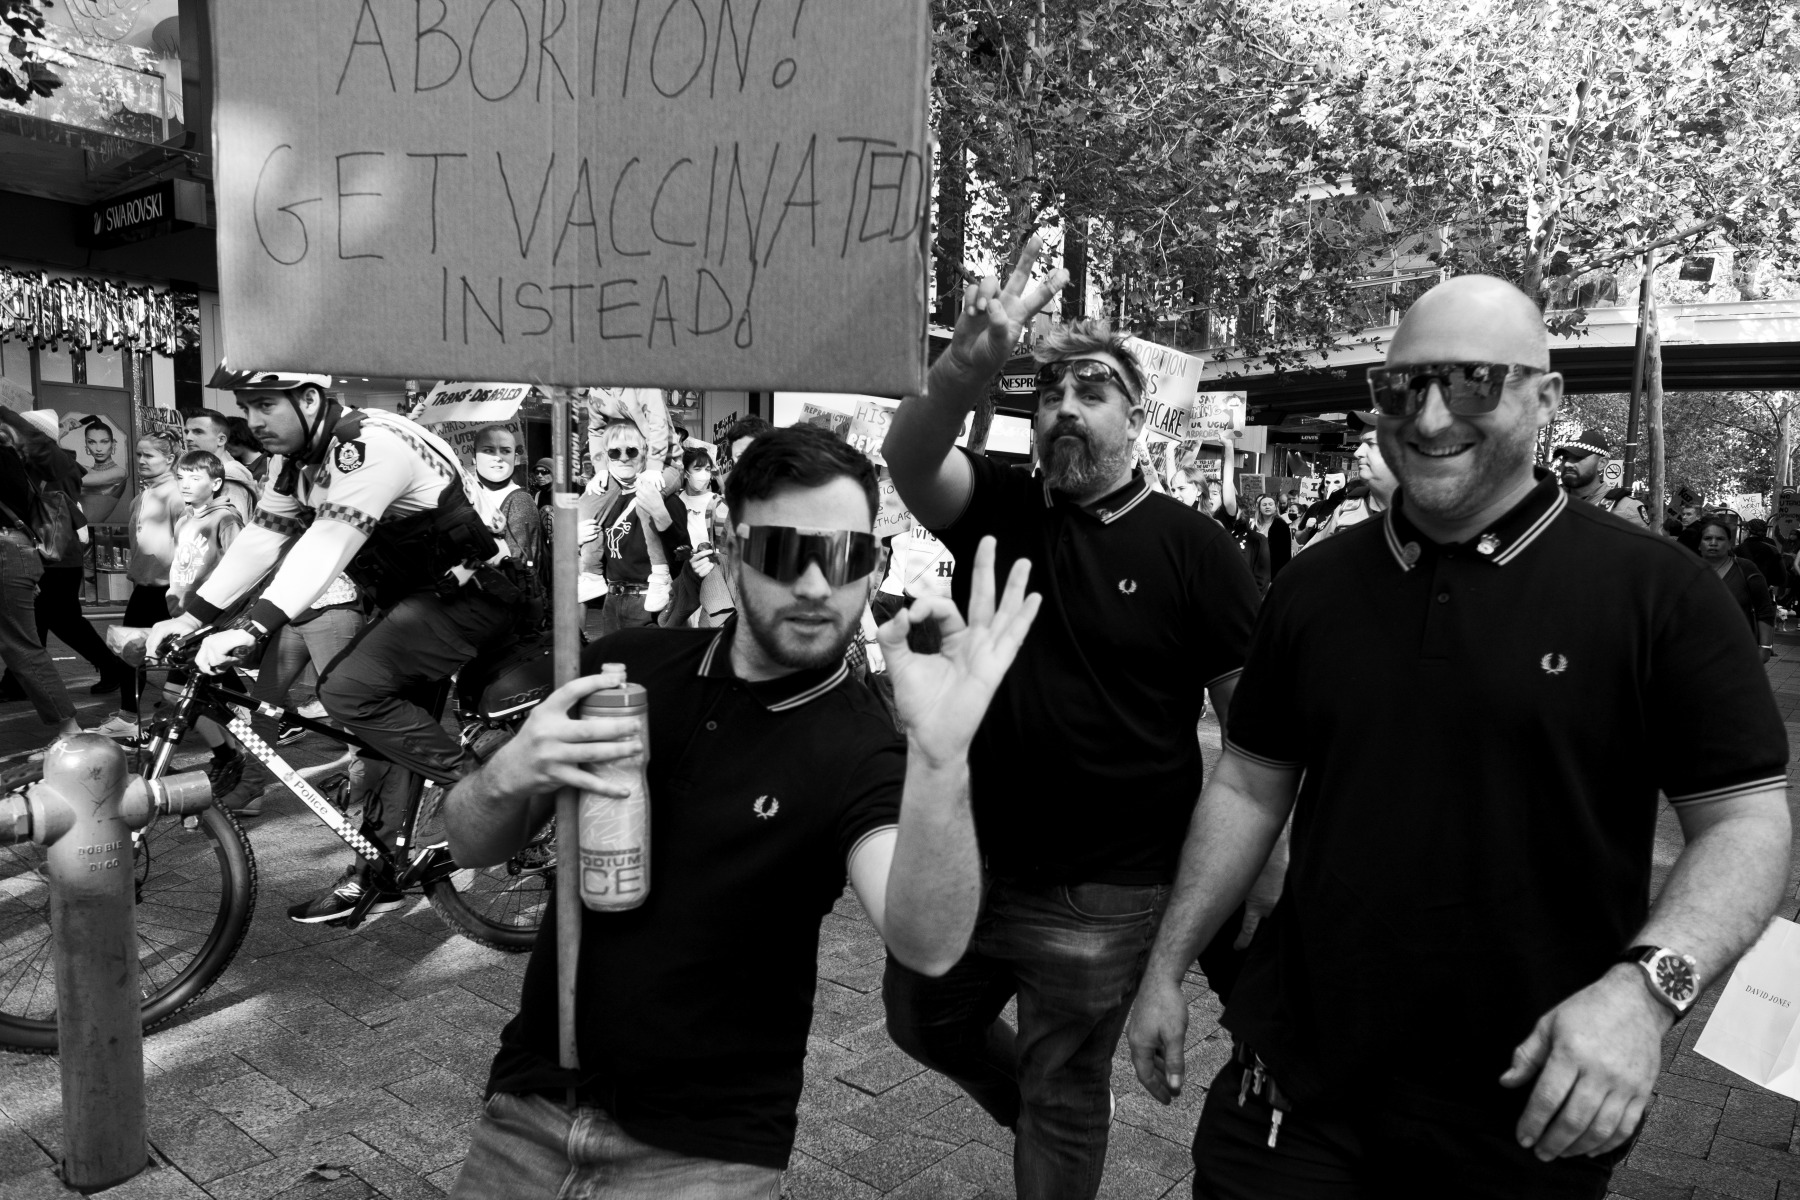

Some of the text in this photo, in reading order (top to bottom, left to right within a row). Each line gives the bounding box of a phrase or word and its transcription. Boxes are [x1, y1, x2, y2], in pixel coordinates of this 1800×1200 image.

[105, 192, 163, 231] SWAROVSKI
[253, 133, 924, 269] GET VACCINATED
[442, 260, 758, 349] INSTEAD!
[1134, 343, 1188, 378] BORTION
[1001, 377, 1036, 391] NESPR
[1198, 394, 1217, 404] SAY
[1143, 397, 1185, 438] THCARE
[1207, 421, 1229, 431] UGLY
[1185, 429, 1220, 439] ARDROBE
[294, 780, 328, 815] Police
[78, 840, 123, 856] DOBBIE
[582, 853, 641, 868] ODIUM
[582, 865, 641, 896] CE
[1745, 984, 1792, 1009] DAVID JONES
